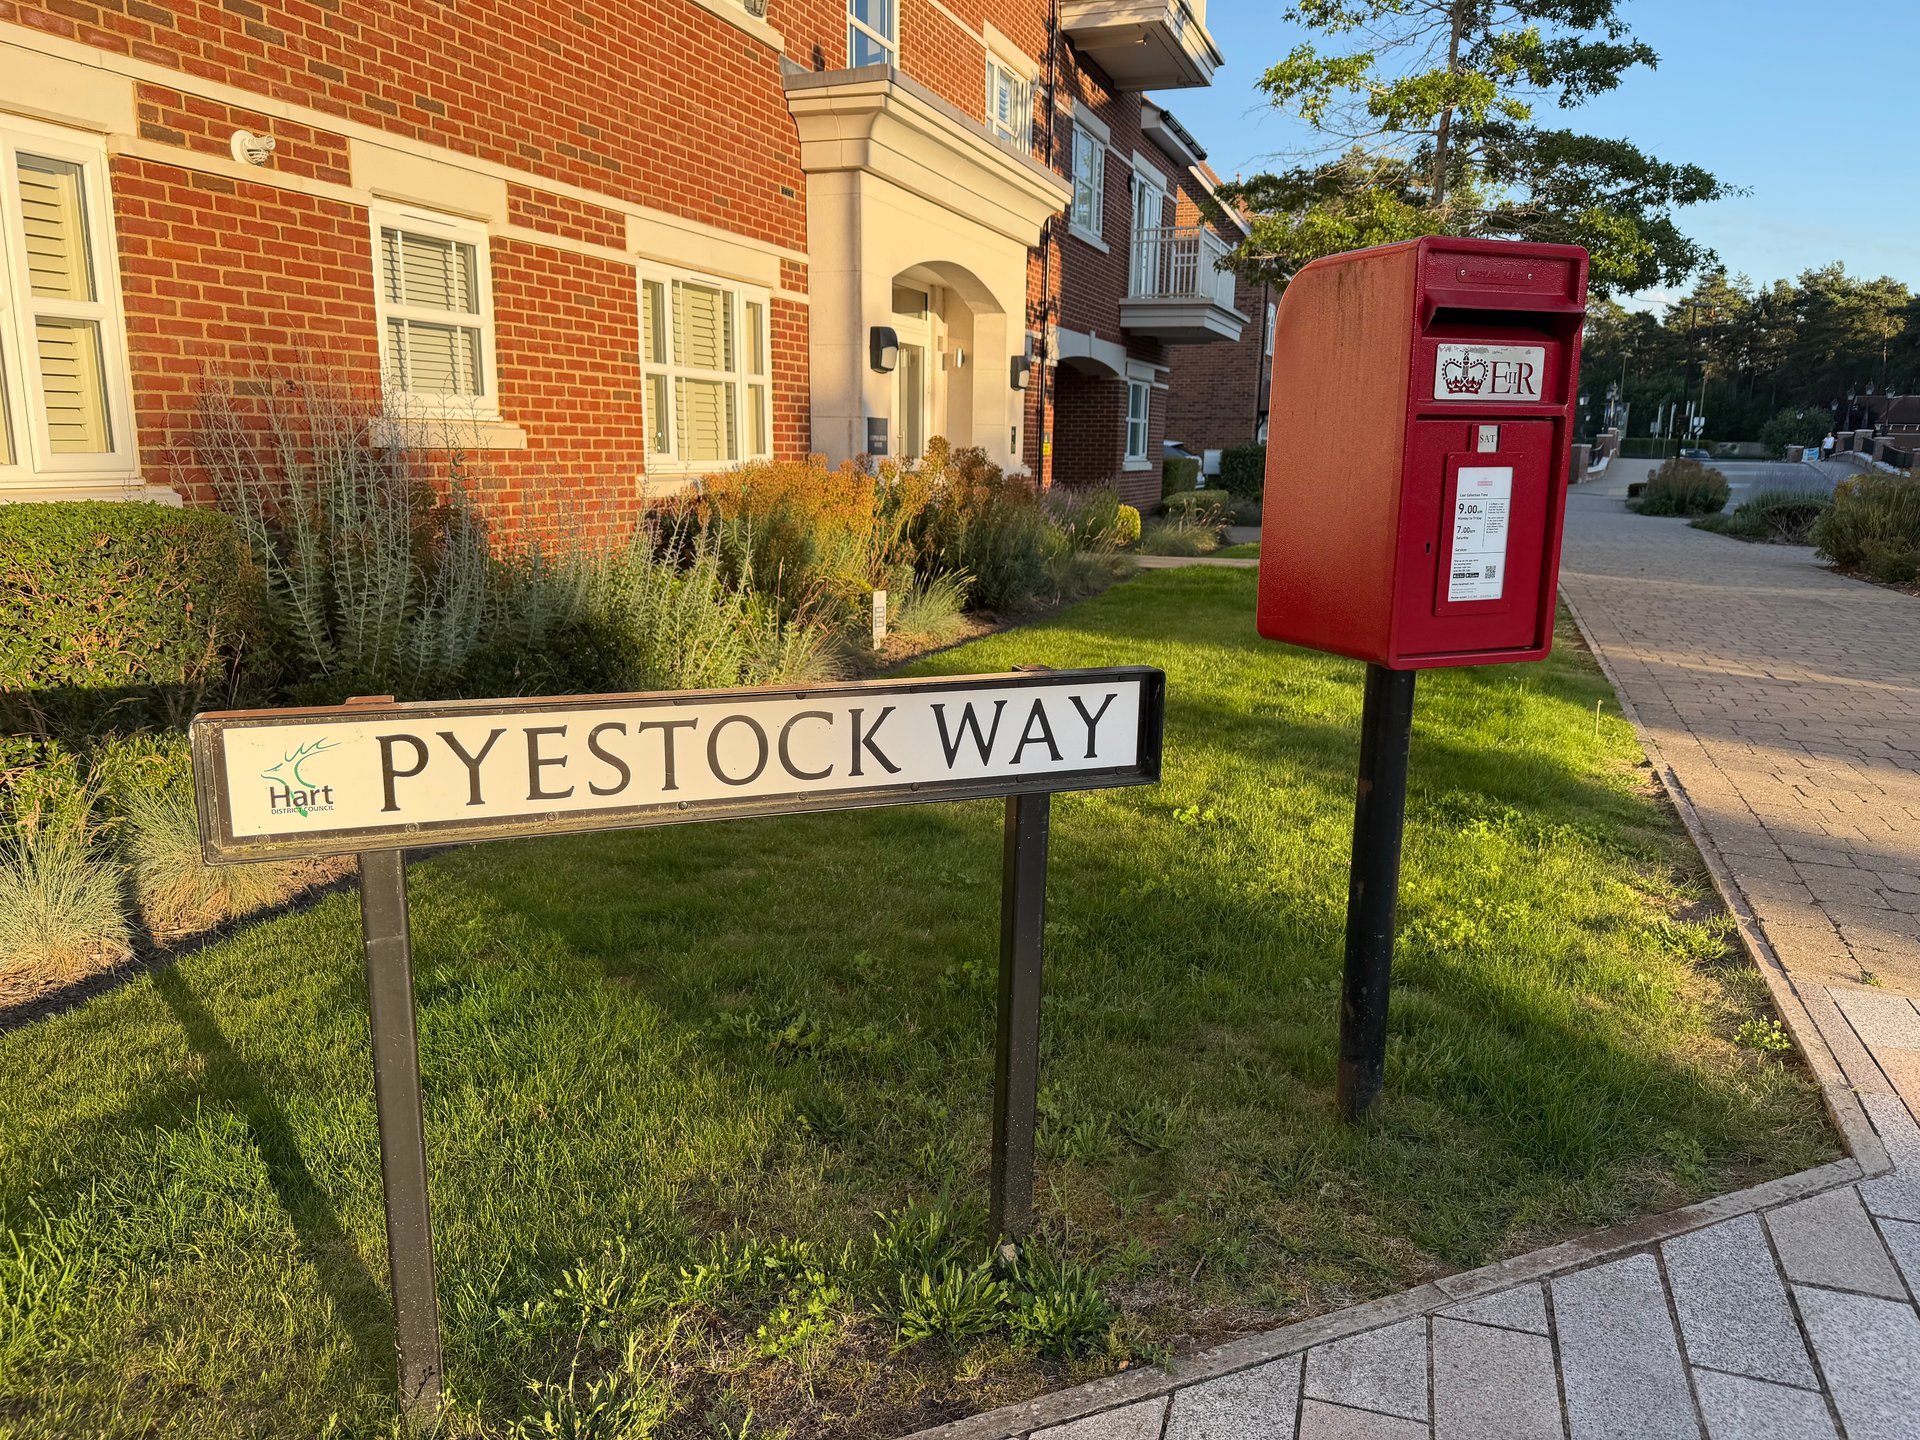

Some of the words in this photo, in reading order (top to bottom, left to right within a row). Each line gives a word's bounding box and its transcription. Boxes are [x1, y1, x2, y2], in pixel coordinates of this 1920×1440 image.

[1479, 434, 1496, 443] SAT
[376, 704, 901, 813] PYESTOCK
[930, 693, 1119, 770] WAY
[269, 784, 334, 808] Hart
[271, 807, 302, 815] DISTRICT
